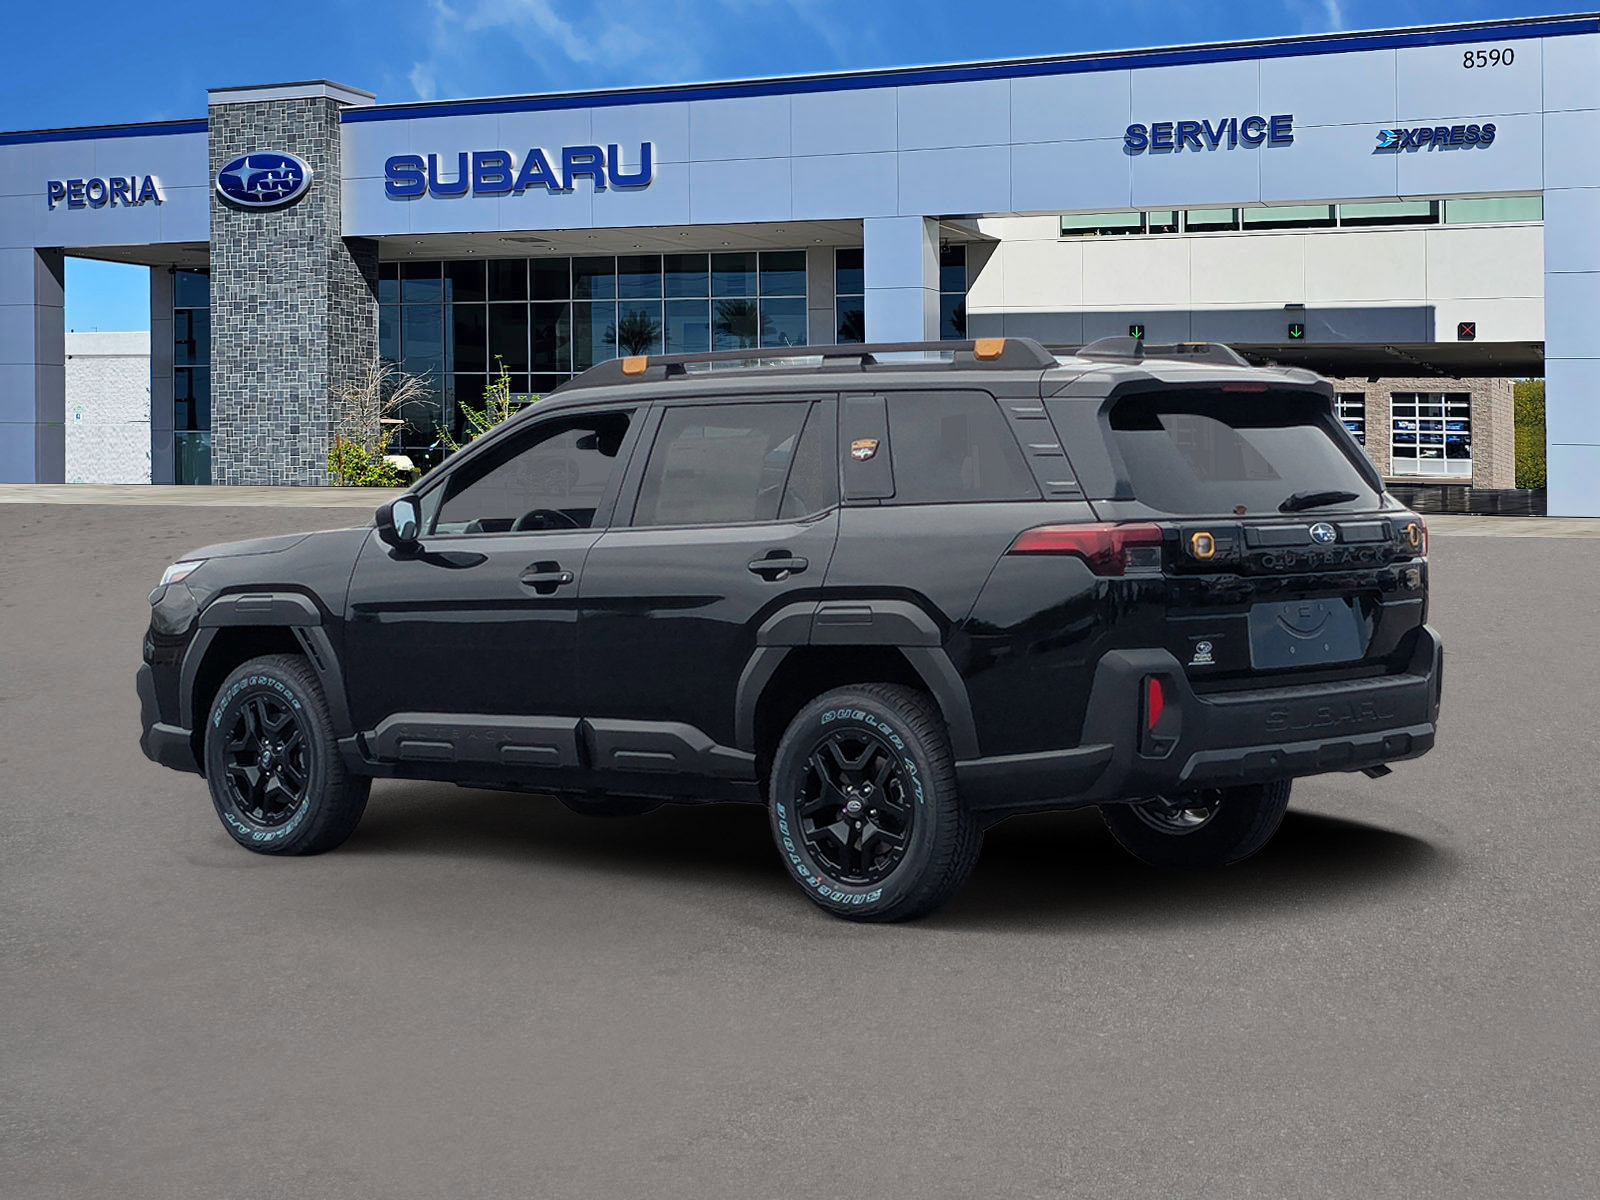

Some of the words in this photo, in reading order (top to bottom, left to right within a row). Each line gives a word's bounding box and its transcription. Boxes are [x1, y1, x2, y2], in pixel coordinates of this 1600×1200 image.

[1462, 47, 1515, 70] 8590
[1125, 114, 1294, 153] SERVICE
[1376, 122, 1496, 152] EXPRESS
[385, 142, 653, 200] SUBARU
[48, 174, 163, 208] PEORIA
[821, 708, 904, 750] DUELER
